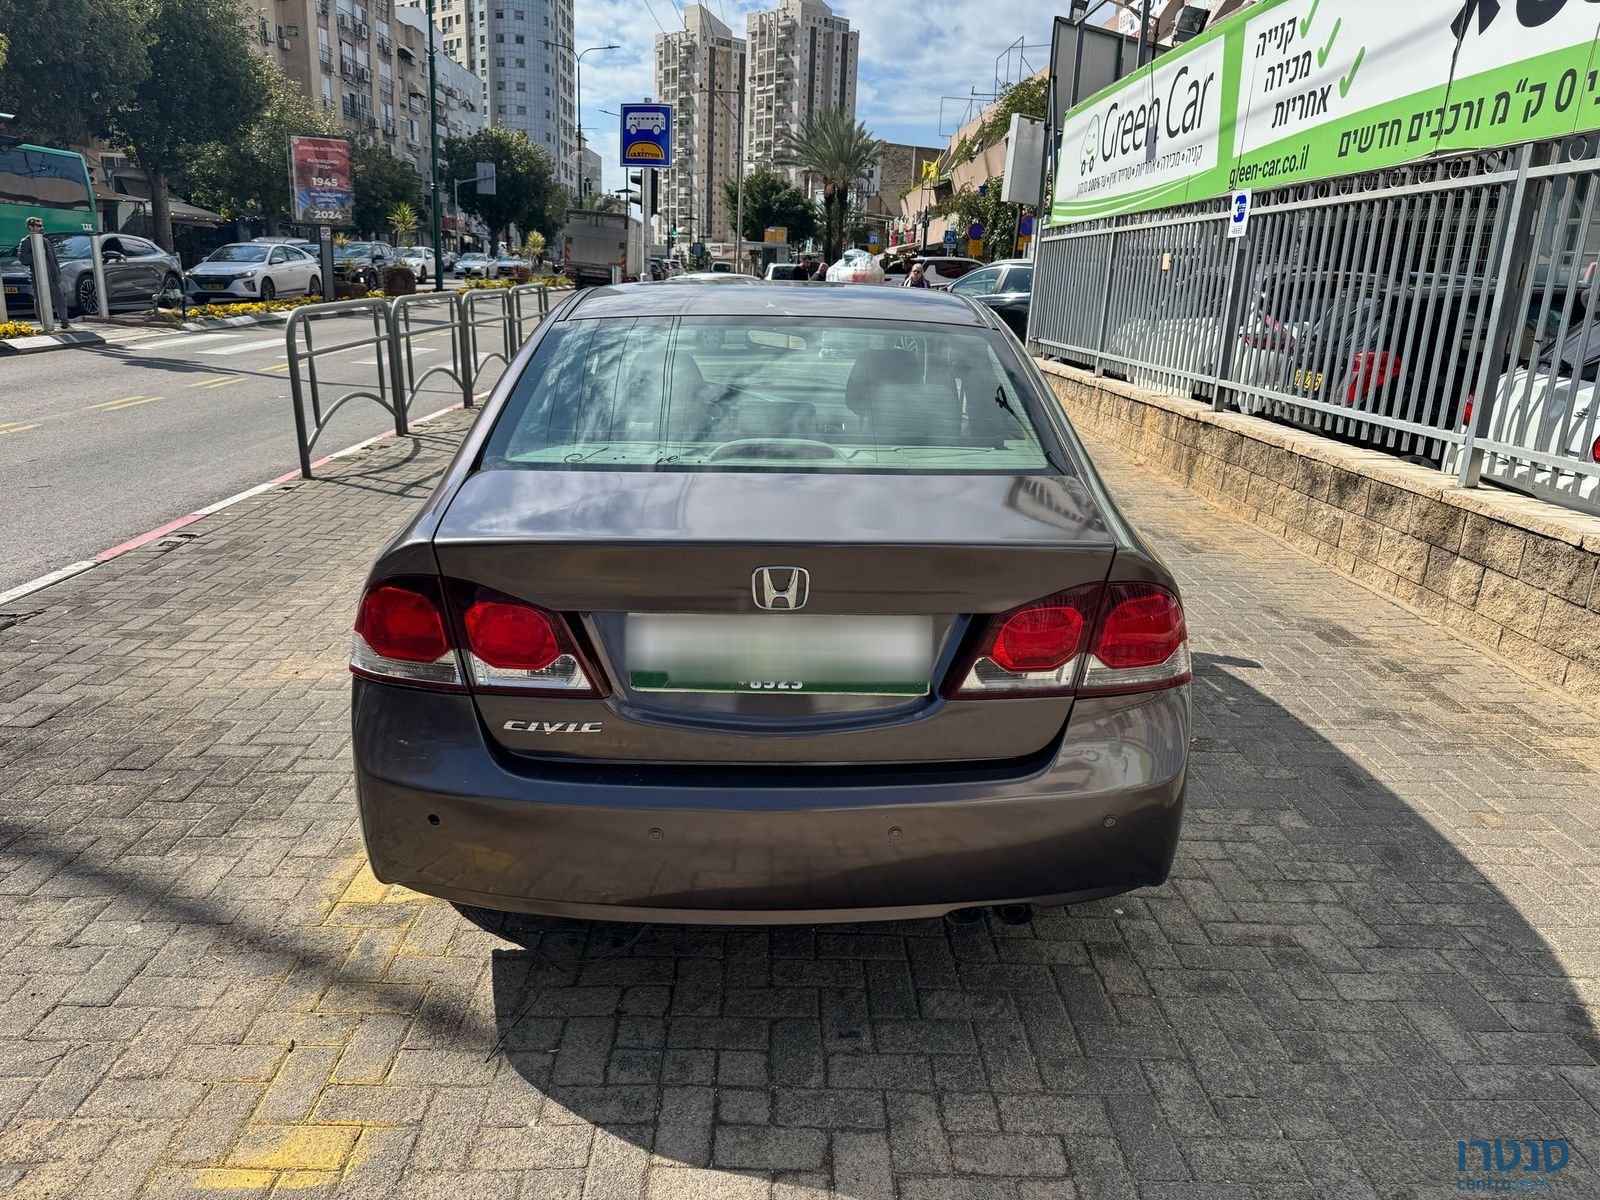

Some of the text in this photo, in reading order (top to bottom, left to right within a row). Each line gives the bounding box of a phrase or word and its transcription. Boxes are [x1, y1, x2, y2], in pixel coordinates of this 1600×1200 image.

[1255, 16, 1298, 58] קנייה
[1264, 50, 1312, 92] מכירה
[1101, 65, 1214, 162] Green Car
[1271, 84, 1332, 129] אחריות
[1406, 97, 1485, 143] ורכבים
[1337, 118, 1402, 158] חדשים
[311, 177, 338, 187] 1945
[1228, 144, 1310, 190] green-car.co.il
[314, 210, 343, 220] 2024
[503, 719, 602, 735] CIVIC
